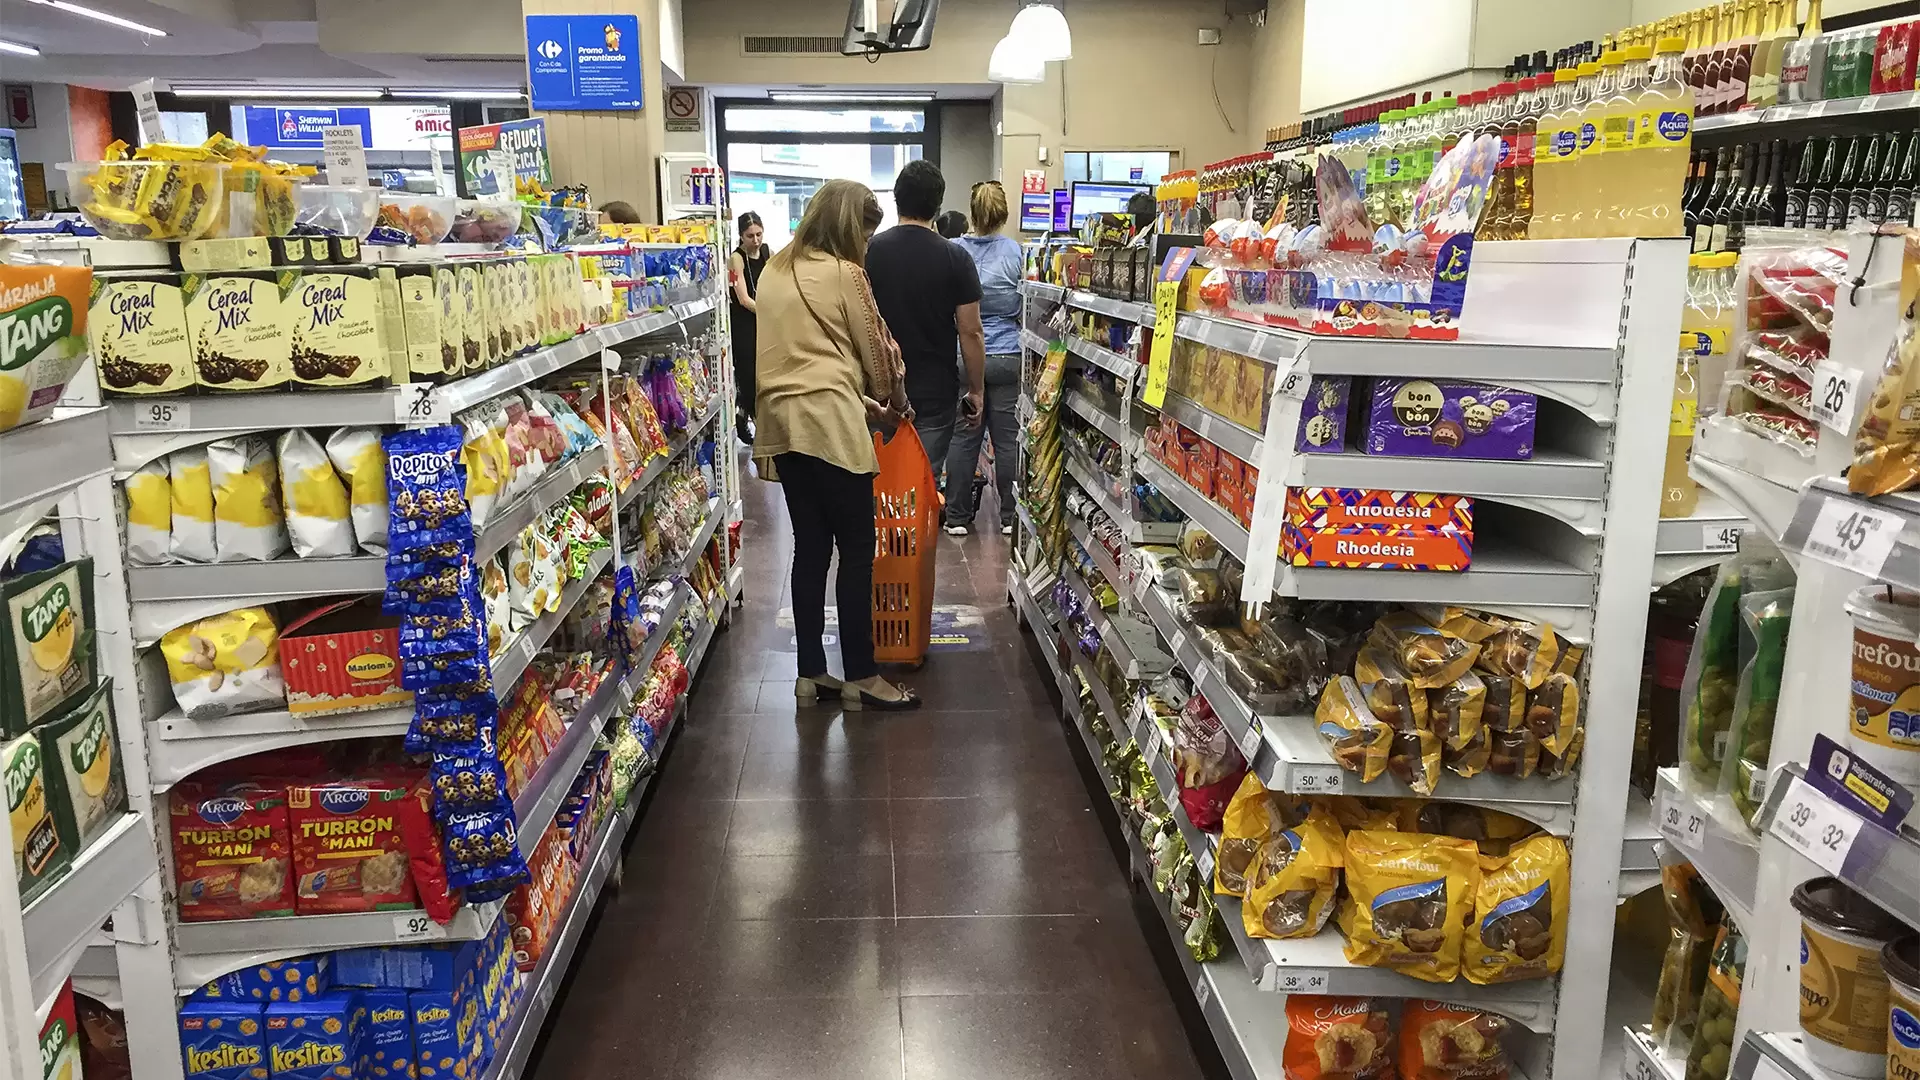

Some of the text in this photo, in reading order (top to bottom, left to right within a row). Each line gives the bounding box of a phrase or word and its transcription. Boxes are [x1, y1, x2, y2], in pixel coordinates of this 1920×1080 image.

[578, 46, 603, 54] Promo
[578, 54, 626, 63] garantizada
[298, 115, 333, 125] SHERWIN
[298, 124, 323, 132] WILLIA
[324, 129, 354, 137] ROCKLETS
[500, 124, 542, 151] REDUCÍ
[110, 284, 156, 315] Cereal
[208, 280, 255, 312] Cereal
[302, 276, 349, 308] Cereal
[117, 312, 154, 339] Mix
[214, 306, 251, 336] Mix
[308, 304, 345, 332] Mix
[146, 333, 186, 348] Chocolate
[243, 329, 282, 345] Chocolate
[336, 326, 376, 340] Chocolate
[180, 366, 186, 377] 6
[276, 362, 282, 373] 6
[368, 358, 374, 369] 6
[1408, 391, 1432, 402] bon
[1406, 410, 1430, 422] bon
[391, 451, 452, 480] Pepitos
[1336, 540, 1416, 558] Rhodesia
[28, 587, 65, 640] TANG
[76, 715, 104, 771] TANG
[5, 747, 36, 810] TANG
[1851, 760, 1896, 798] Registrate en
[321, 789, 368, 804] ARCOR
[200, 800, 246, 814] ARCOR
[178, 824, 270, 845] TURRÓN
[300, 814, 393, 838] TURRÓN
[207, 840, 252, 857] MANÍ
[372, 1008, 405, 1024] kesitas
[186, 1041, 261, 1074] kesitas
[271, 1040, 346, 1073] kesitas
